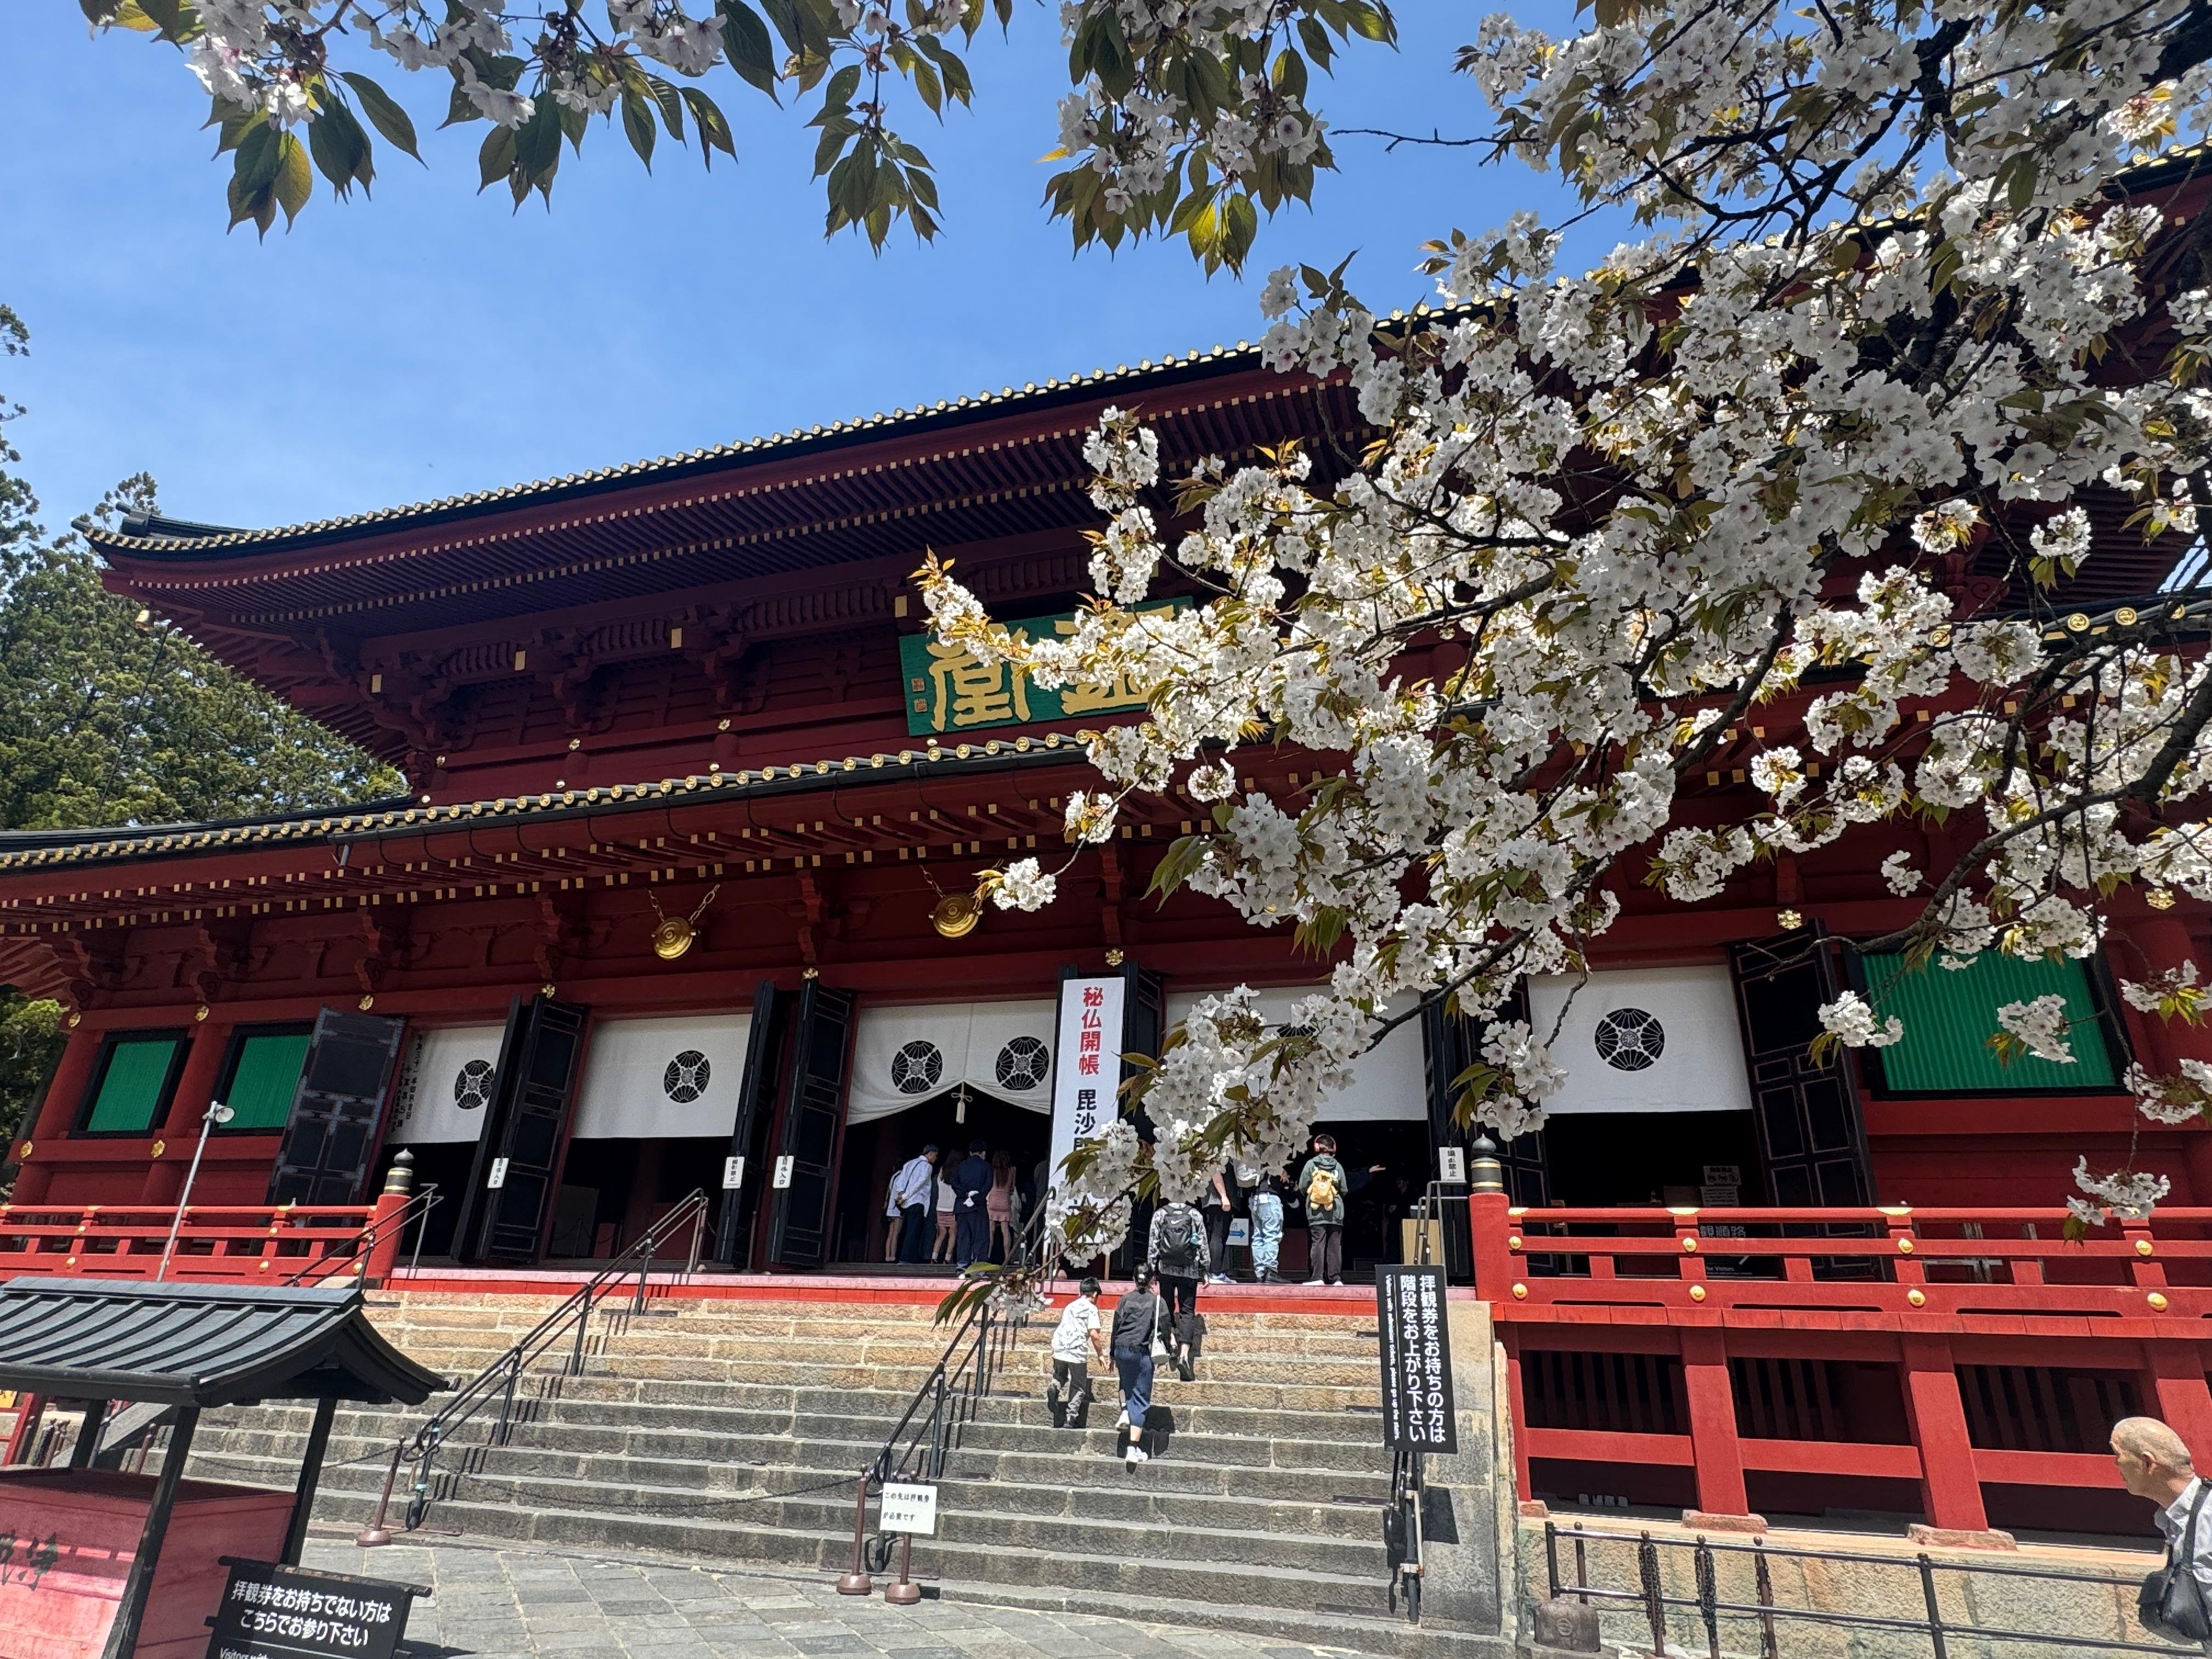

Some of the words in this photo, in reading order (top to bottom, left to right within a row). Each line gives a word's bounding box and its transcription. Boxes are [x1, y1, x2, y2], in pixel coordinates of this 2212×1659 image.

[1079, 986, 1104, 1076] 秘仏開帳
[1400, 1274, 1426, 1442] 階段をお上がり下さい
[1419, 1274, 1446, 1442] 拝観券をお持ちの方は
[882, 1511, 916, 1522] が必要です
[231, 1579, 393, 1623] 拝観券をお持ちでない方は
[240, 1609, 369, 1646] こちらでお参り下さい
